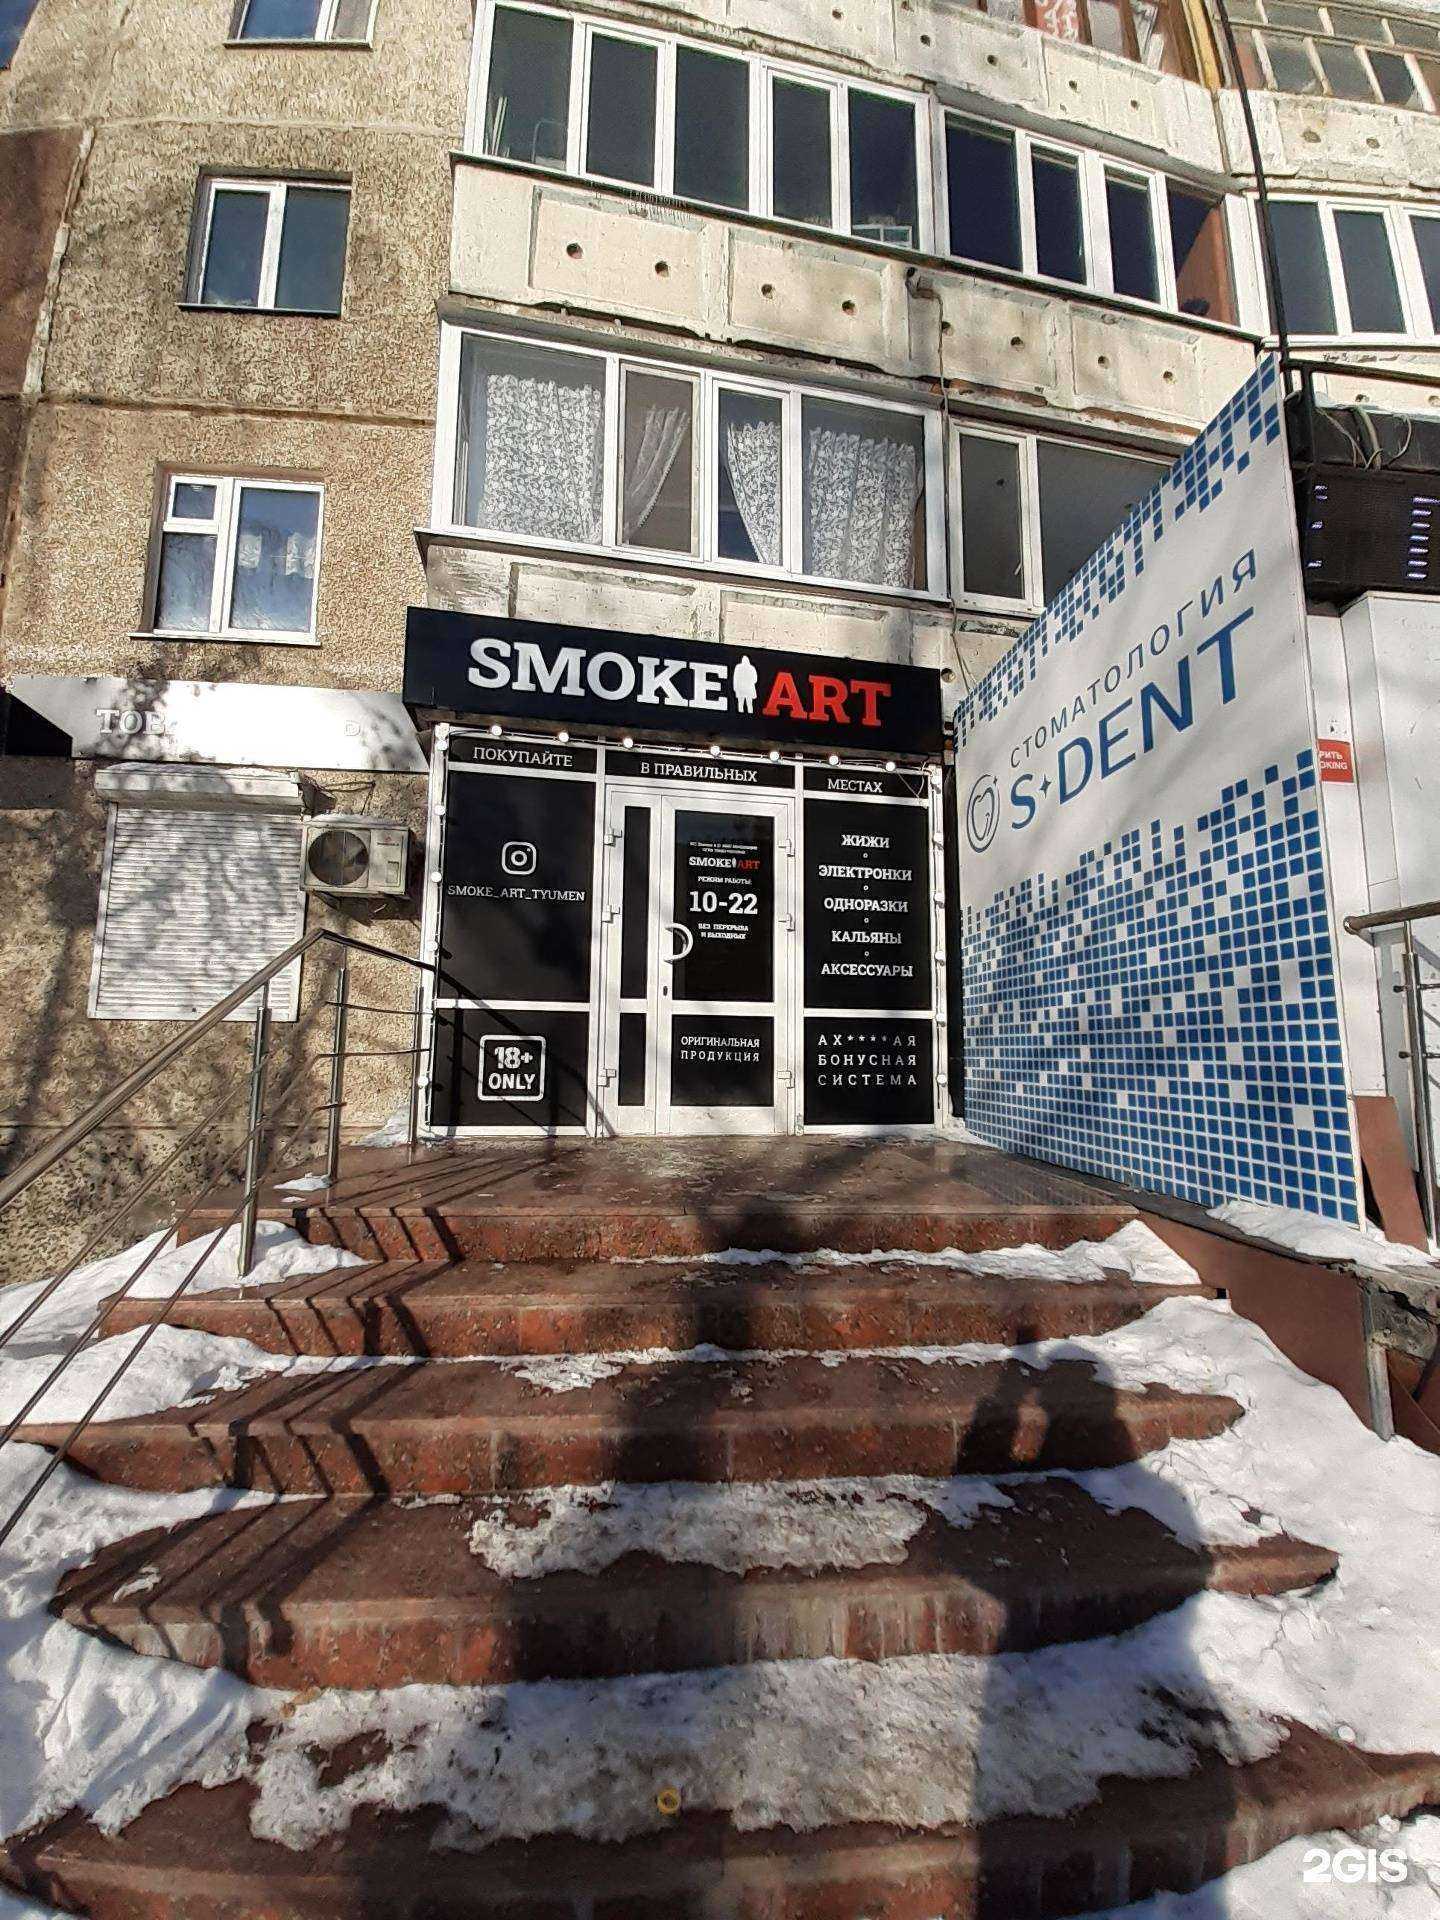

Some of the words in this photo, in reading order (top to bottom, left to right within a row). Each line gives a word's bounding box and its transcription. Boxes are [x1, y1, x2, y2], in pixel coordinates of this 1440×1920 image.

[1009, 548, 1258, 769] СТОМАТОЛОГИЯ
[468, 637, 728, 712] SMOKE
[762, 672, 892, 727] ART
[472, 746, 573, 767] ПОКУПАЙТЕ
[640, 762, 652, 775] В
[654, 762, 758, 783] ПРАВИЛЬНЫХ
[827, 777, 883, 793] МЕСТАХ
[841, 834, 890, 849] ЖИЖИ
[688, 856, 732, 868] SMOKE
[818, 865, 913, 881] ЭЛЕКТРОНКИ
[447, 885, 586, 901] SMOKE_ART_TYUMEN
[689, 891, 758, 915] 10-22
[823, 898, 909, 913] ОДНОРАЗКИ
[831, 930, 902, 944] КАЛЬЯНЫ
[821, 963, 914, 977] АКСЕССУАРЫ
[680, 1036, 760, 1048] ОРИГИНАЛЬНАЯ
[494, 1046, 534, 1069] 18+
[680, 1050, 760, 1062] ПРОДУКЦИЯ
[817, 1054, 917, 1066] БОНУСНАЯ
[488, 1072, 536, 1090] ONLY
[817, 1074, 917, 1086] СИСТЕМА
